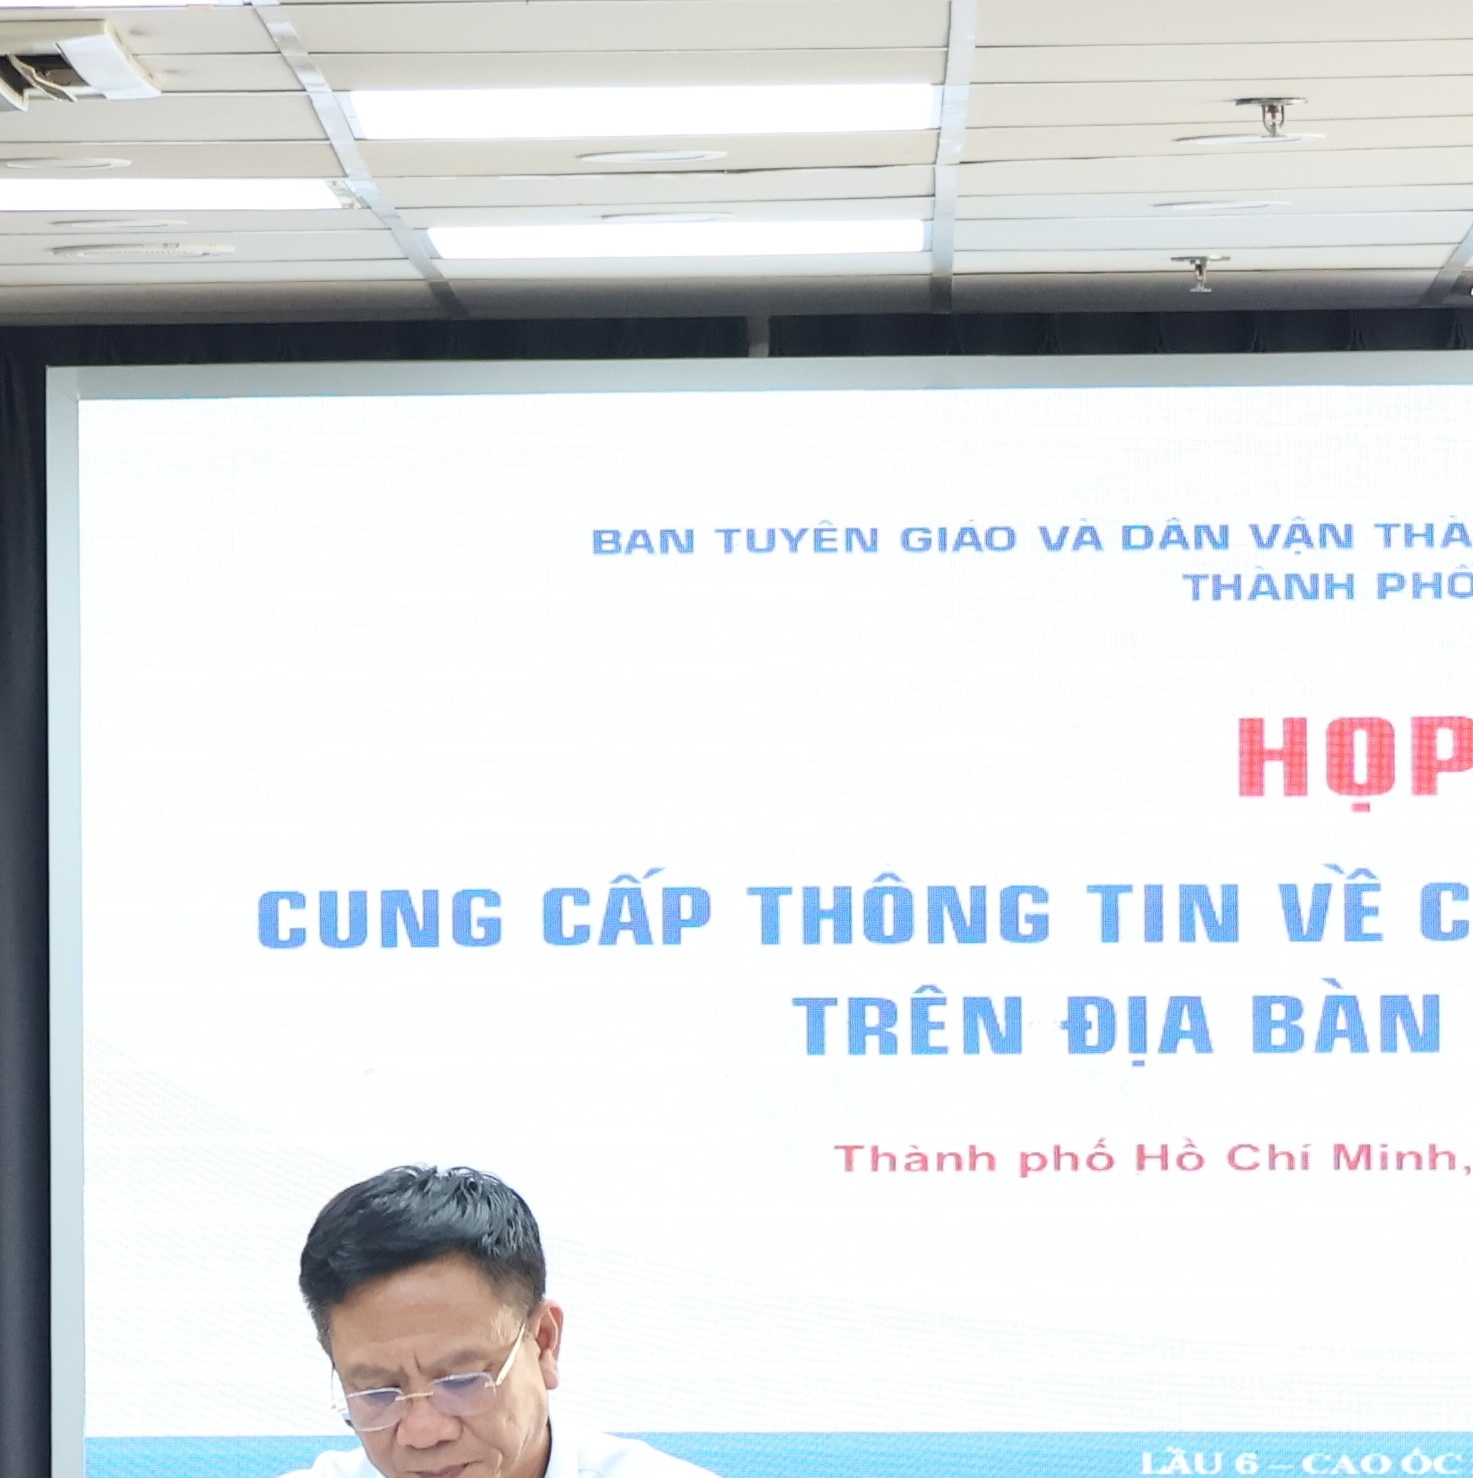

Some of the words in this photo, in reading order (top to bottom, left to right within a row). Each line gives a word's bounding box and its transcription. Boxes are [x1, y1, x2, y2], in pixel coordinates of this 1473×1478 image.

[592, 528, 695, 556] BAN
[716, 519, 879, 555] TUYÊN
[900, 519, 1017, 554] GIÁO
[1038, 517, 1104, 553] VÀ
[1121, 517, 1230, 552] DÂN
[1249, 515, 1355, 555] VẬN
[1182, 566, 1355, 602] THÀNH
[257, 887, 503, 950] CUNG
[541, 866, 712, 947] CẤP
[746, 871, 1051, 946] THÔNG
[1086, 883, 1241, 945] TIN
[1278, 863, 1384, 944] VỀ
[791, 983, 1024, 1057] TRÊN
[1059, 994, 1215, 1068] ĐỊA
[1252, 977, 1441, 1055] BÀN
[834, 1144, 997, 1172] Thành
[1018, 1137, 1116, 1178] phố
[1135, 1137, 1206, 1172] Hồ
[1226, 1143, 1312, 1171] Chí
[1332, 1143, 1473, 1177] Minh,
[1234, 1452, 1260, 1475] 6
[1301, 1452, 1394, 1475] CAO
